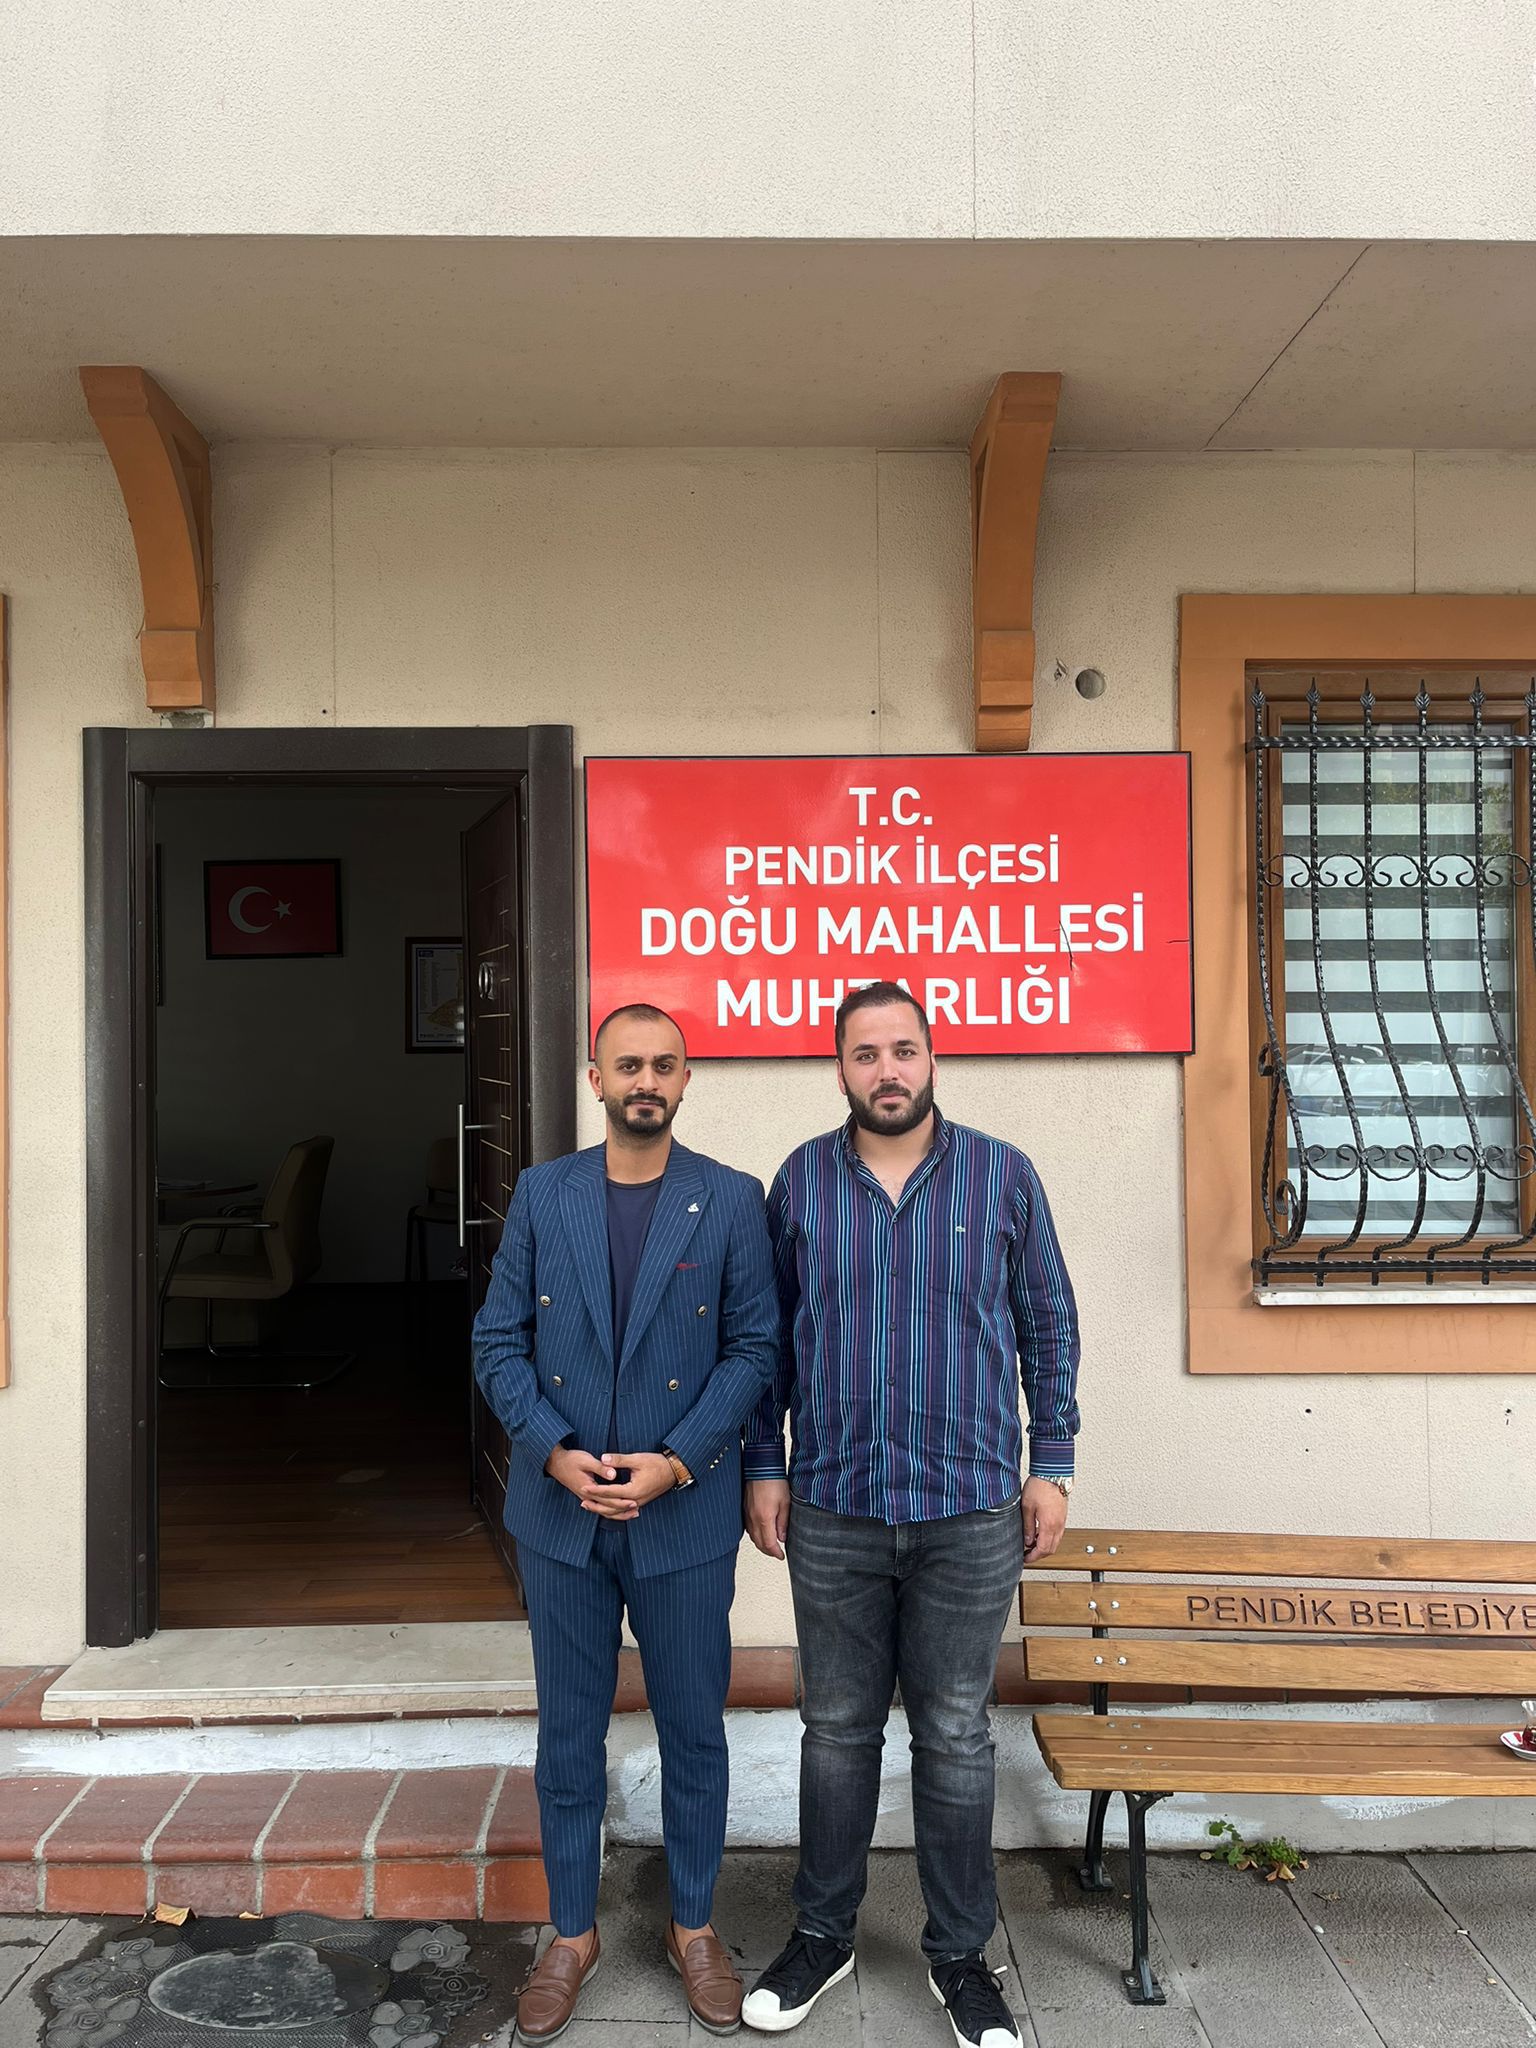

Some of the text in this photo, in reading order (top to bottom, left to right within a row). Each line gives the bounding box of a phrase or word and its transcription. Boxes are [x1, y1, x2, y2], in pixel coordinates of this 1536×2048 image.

[848, 786, 933, 826] T.C.
[725, 834, 1059, 890] PENDİK İLÇESİ
[641, 892, 1144, 956] DOĞU MAHALLESİ
[716, 965, 1071, 1027] MUHRLIĞI
[1187, 1593, 1337, 1626] PENDİK
